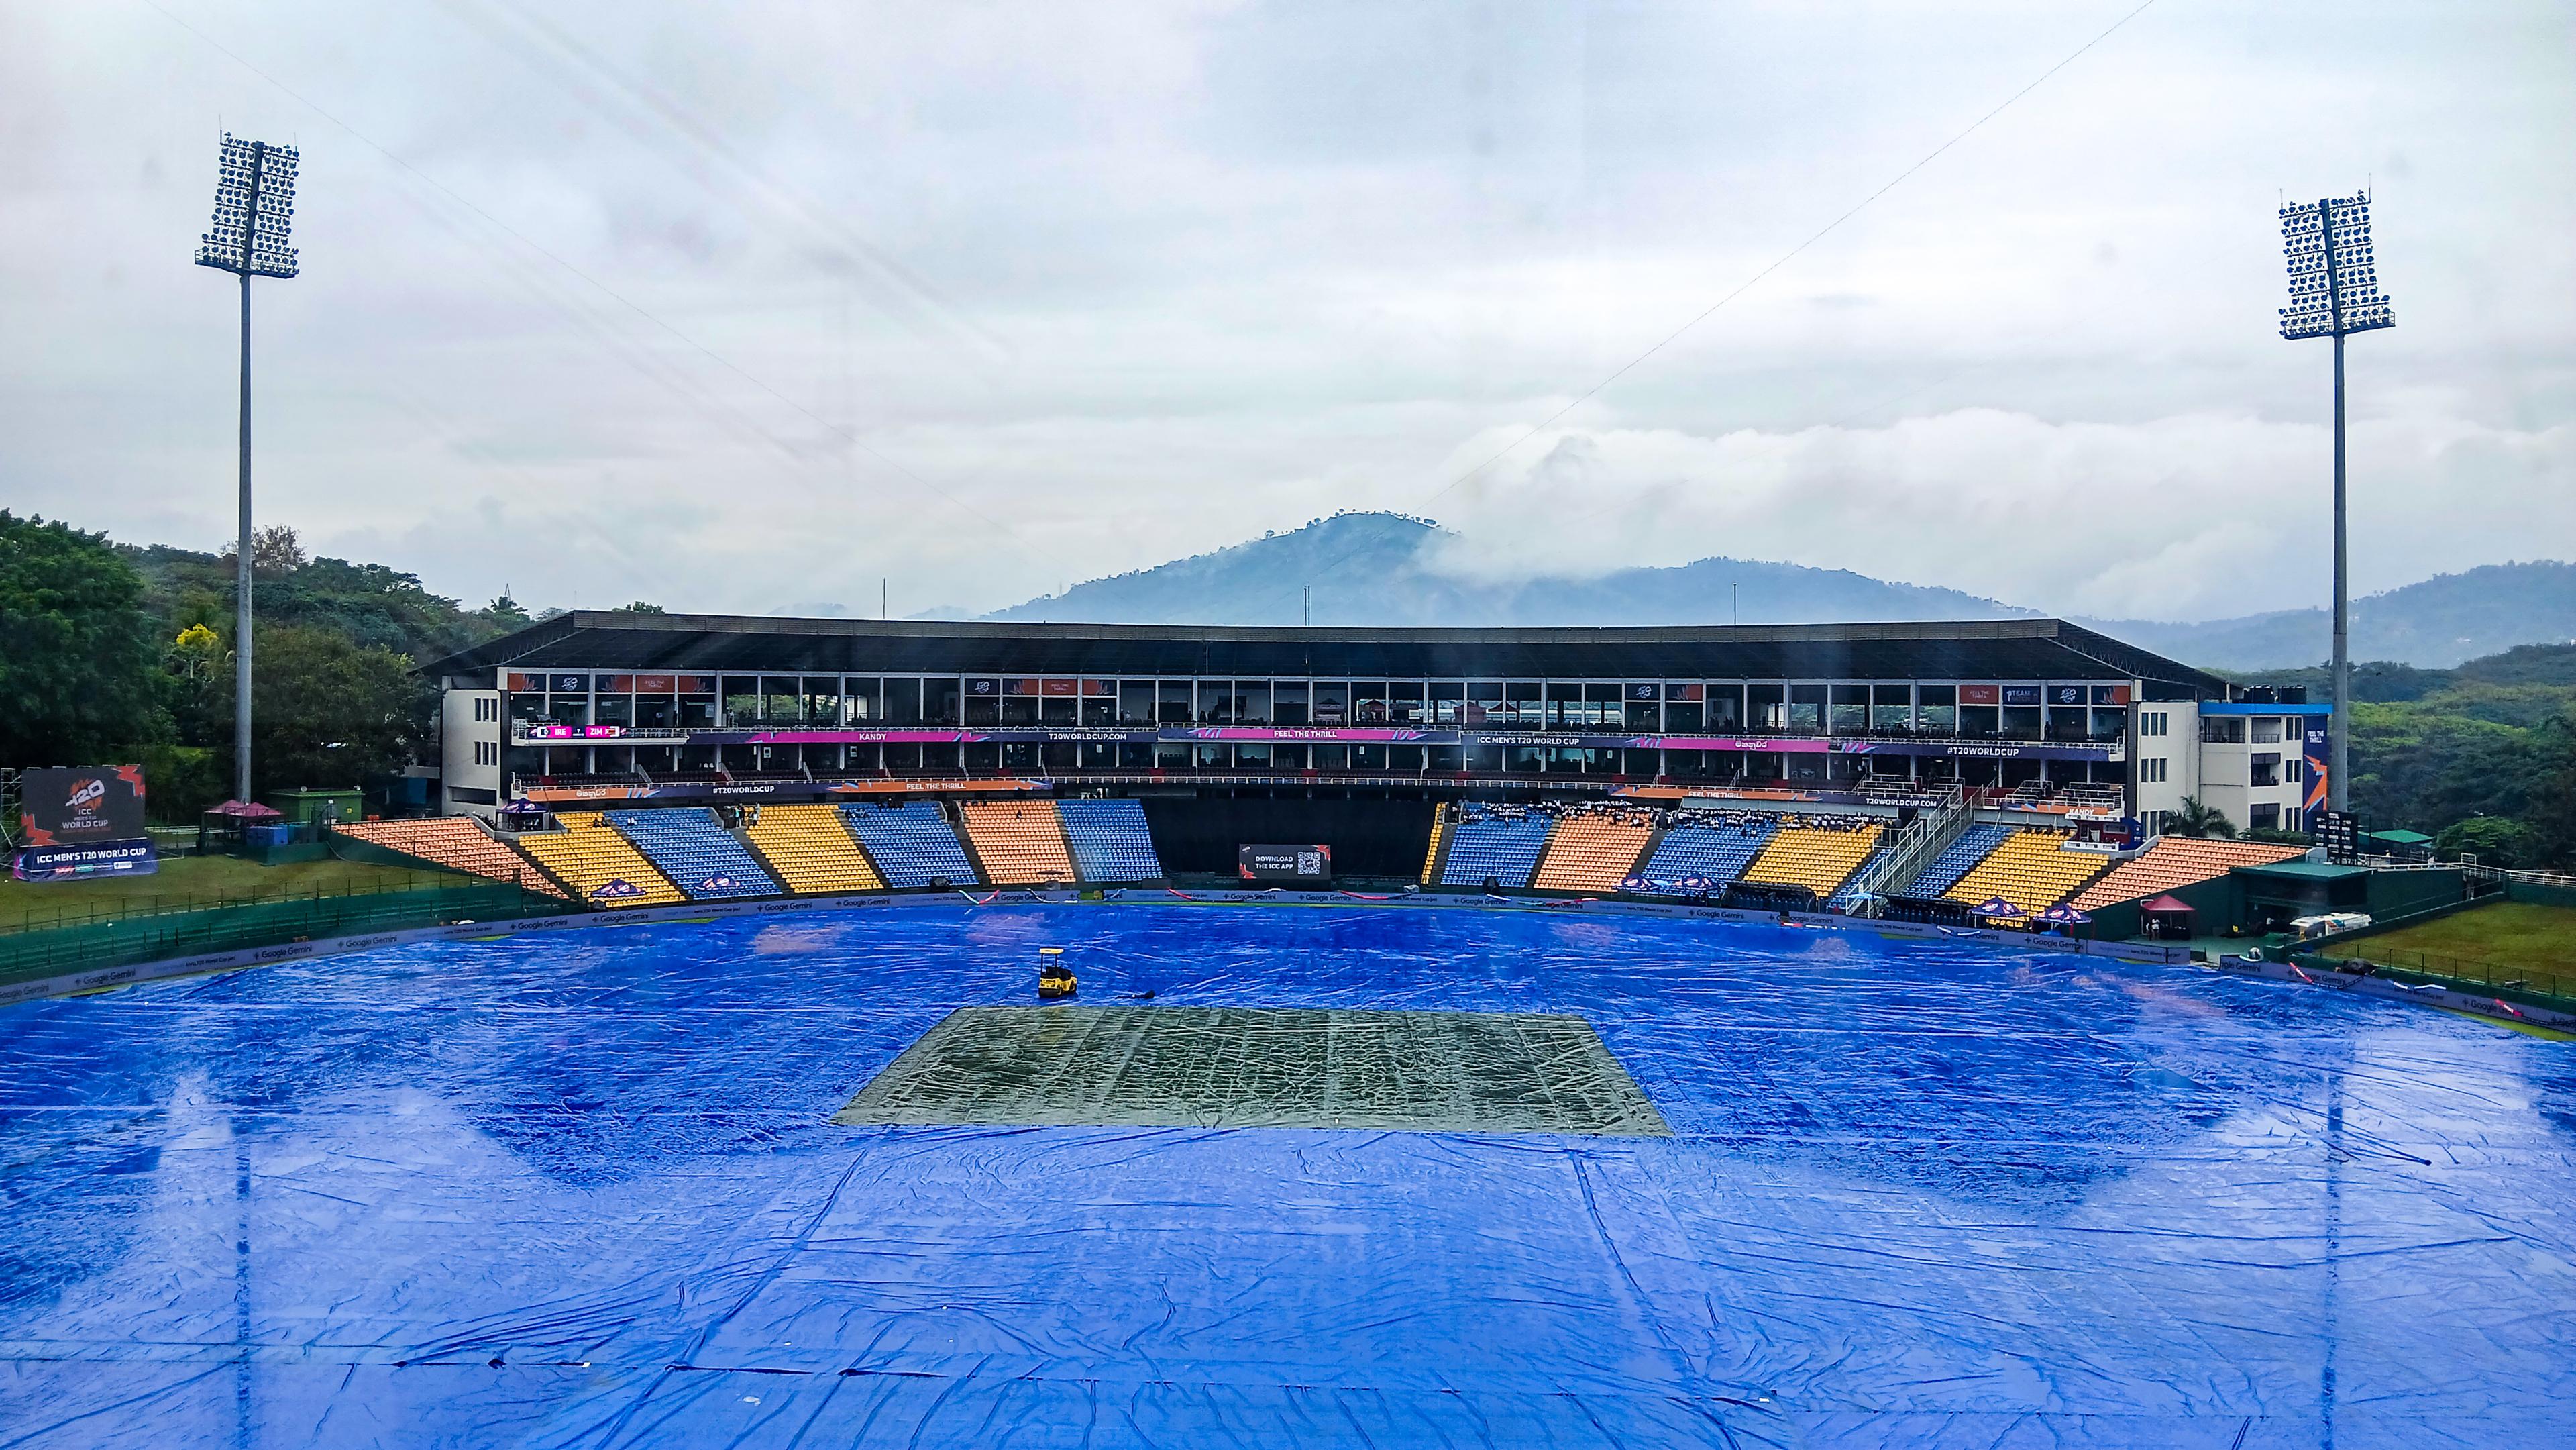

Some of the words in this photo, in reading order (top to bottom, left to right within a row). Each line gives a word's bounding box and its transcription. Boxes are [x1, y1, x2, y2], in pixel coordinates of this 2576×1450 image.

[1049, 733, 1127, 741] T20WORLDCUP.COM
[1947, 746, 2020, 757] #T20WORLDCUP
[713, 786, 775, 794] #T20WORLDCUP
[1866, 798, 1937, 807] T20WORLDCUP.COM
[62, 821, 91, 829] WORLD
[36, 854, 52, 864] ICC
[54, 852, 80, 862] MEN'S
[81, 851, 97, 860] T20
[97, 849, 127, 858] WORLD
[129, 848, 146, 857] CUP
[843, 899, 867, 907] Google
[868, 898, 890, 906] Gemini
[1001, 894, 1024, 902] Google
[1305, 894, 1328, 902] Google
[1460, 897, 1483, 905] Google
[765, 904, 788, 912] Google
[790, 902, 812, 910] Gemini
[600, 913, 625, 923] Google
[626, 911, 649, 921] Gemini
[1696, 909, 1720, 919] Google
[1721, 911, 1744, 919] Gemini
[518, 921, 543, 931] Google
[544, 919, 568, 927] Gemini
[1811, 916, 1833, 924] Gemini
[346, 938, 371, 947] Google
[372, 935, 398, 945] Gemini
[2033, 938, 2058, 948] Google
[261, 948, 286, 959] Google
[288, 945, 313, 955] Gemini
[2235, 962, 2261, 972] Gemini
[83, 974, 109, 985] Google
[110, 970, 136, 980] Gemini
[23, 984, 49, 995] Gemini
